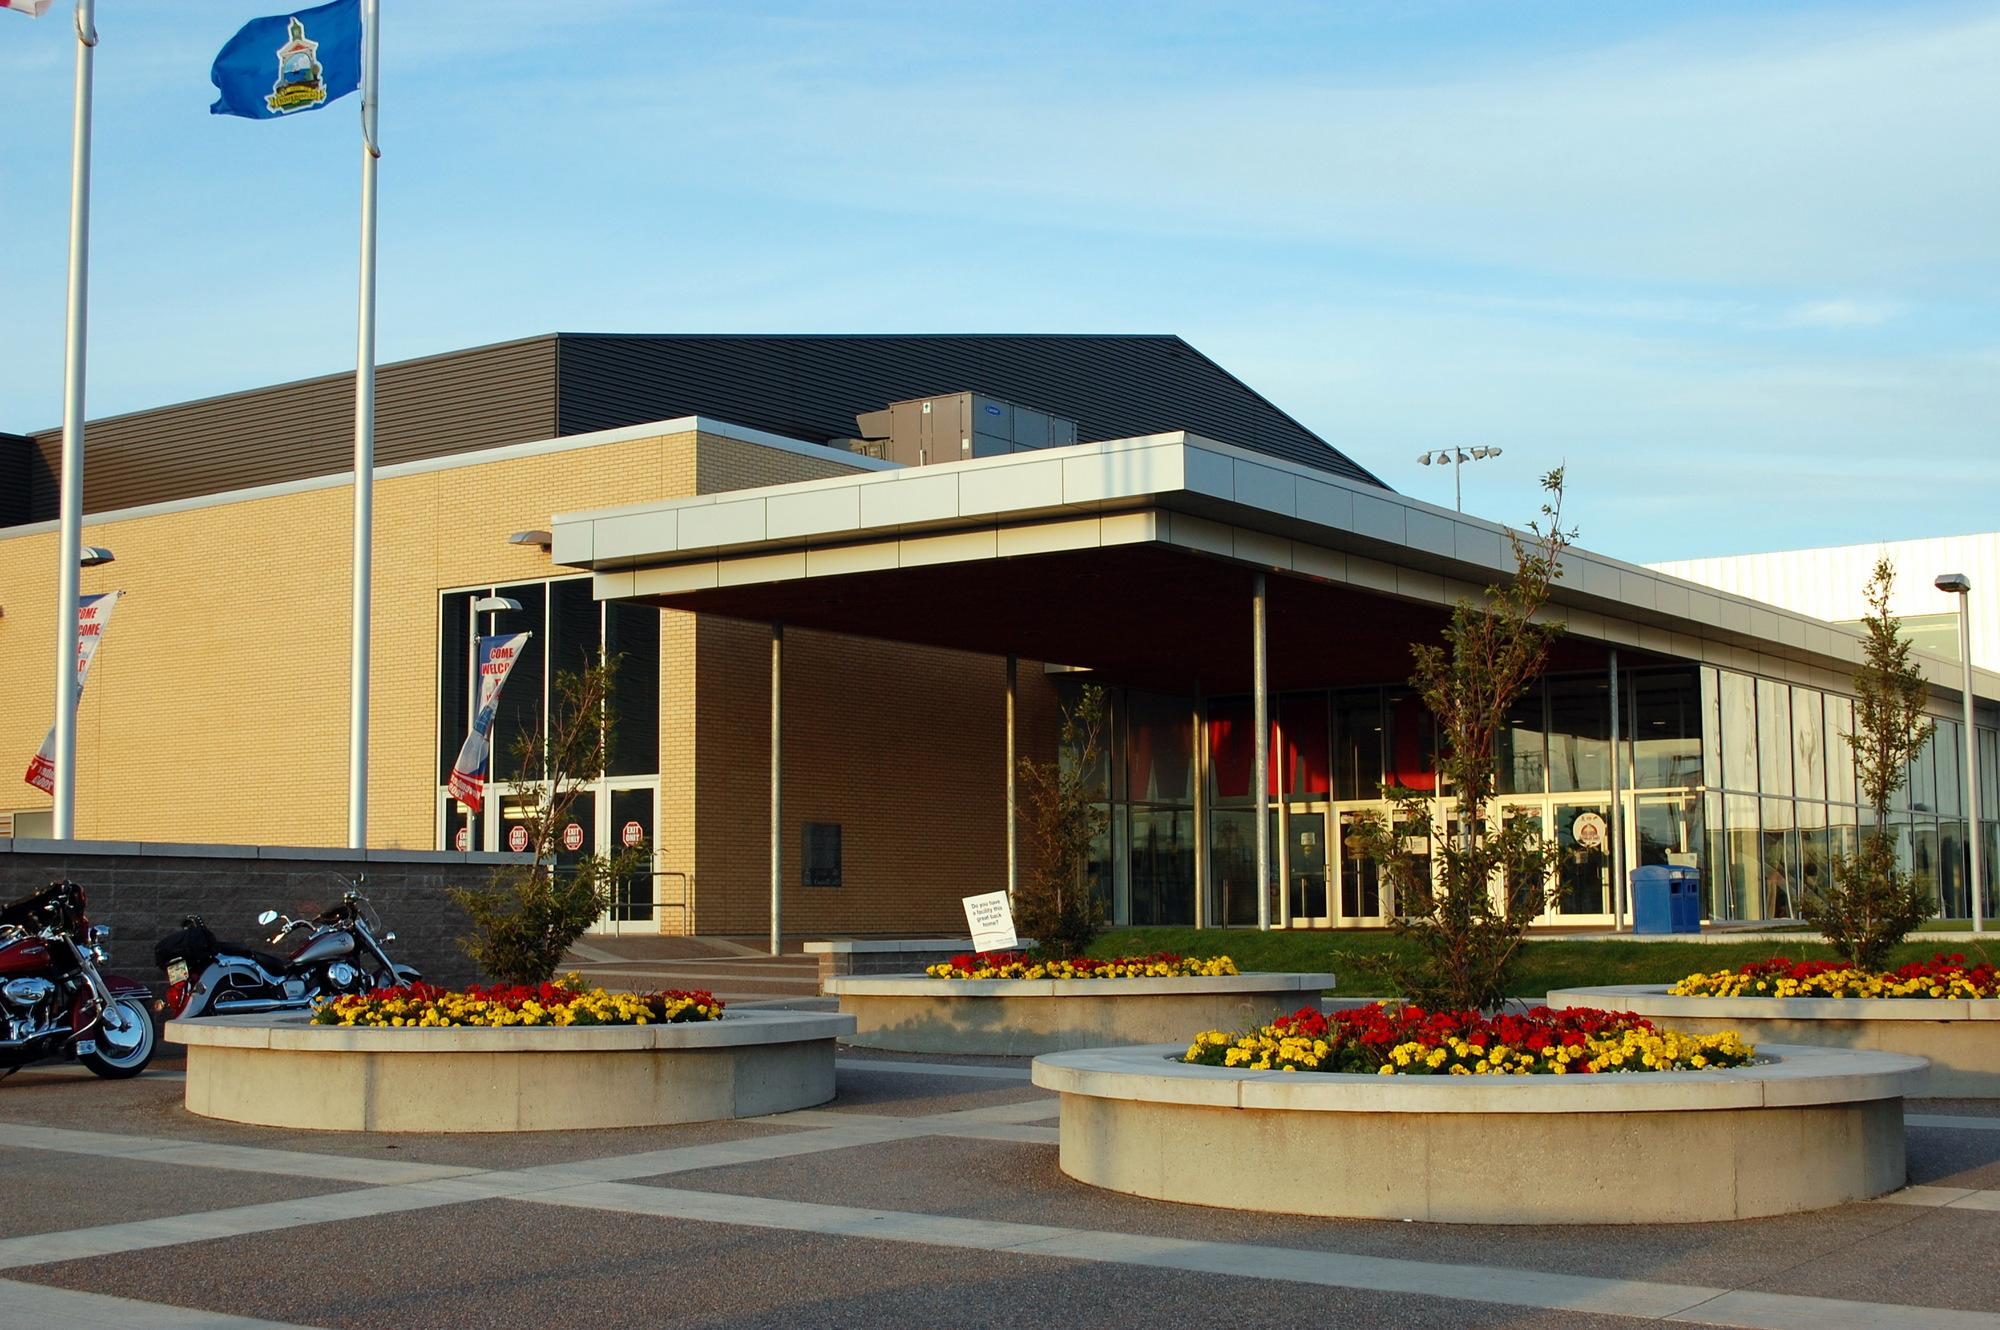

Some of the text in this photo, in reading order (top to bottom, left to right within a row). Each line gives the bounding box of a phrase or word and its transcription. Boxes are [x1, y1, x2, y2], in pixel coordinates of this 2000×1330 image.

[78, 607, 97, 619] OME
[490, 647, 514, 660] COME
[976, 915, 989, 923] great
